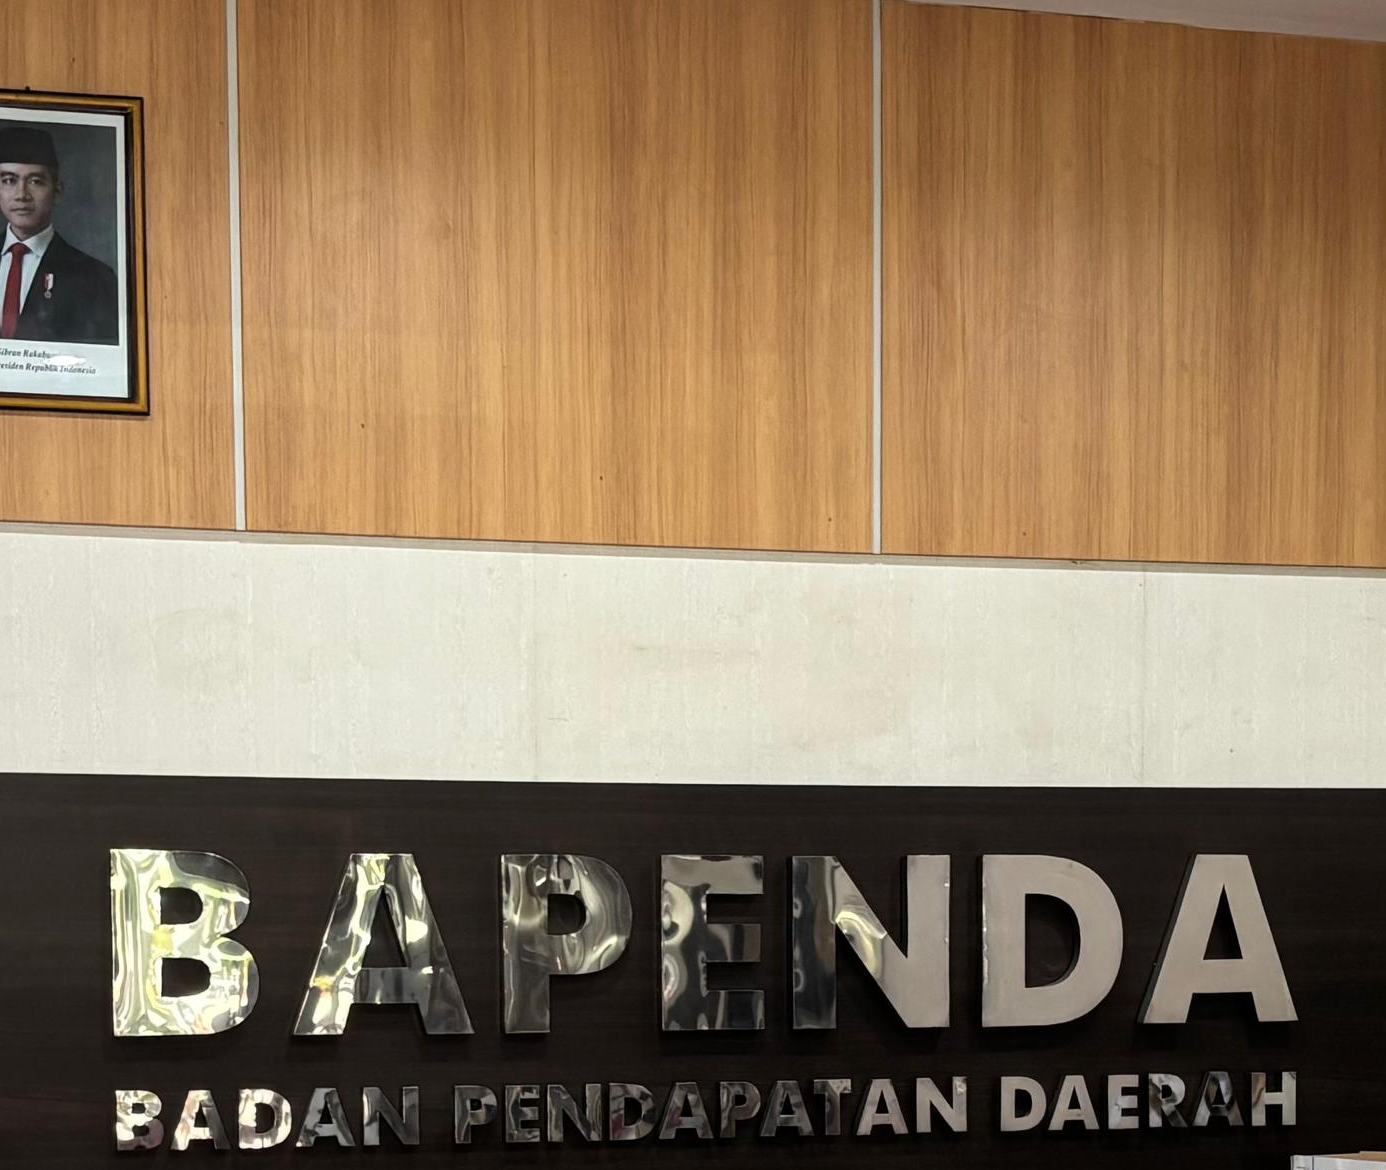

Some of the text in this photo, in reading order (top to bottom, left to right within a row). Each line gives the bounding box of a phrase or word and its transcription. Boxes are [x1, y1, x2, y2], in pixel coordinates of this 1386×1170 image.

[109, 847, 1299, 1039] BAPENDA
[114, 1070, 1298, 1152] BADAN PENDAPATAN DAERAH
